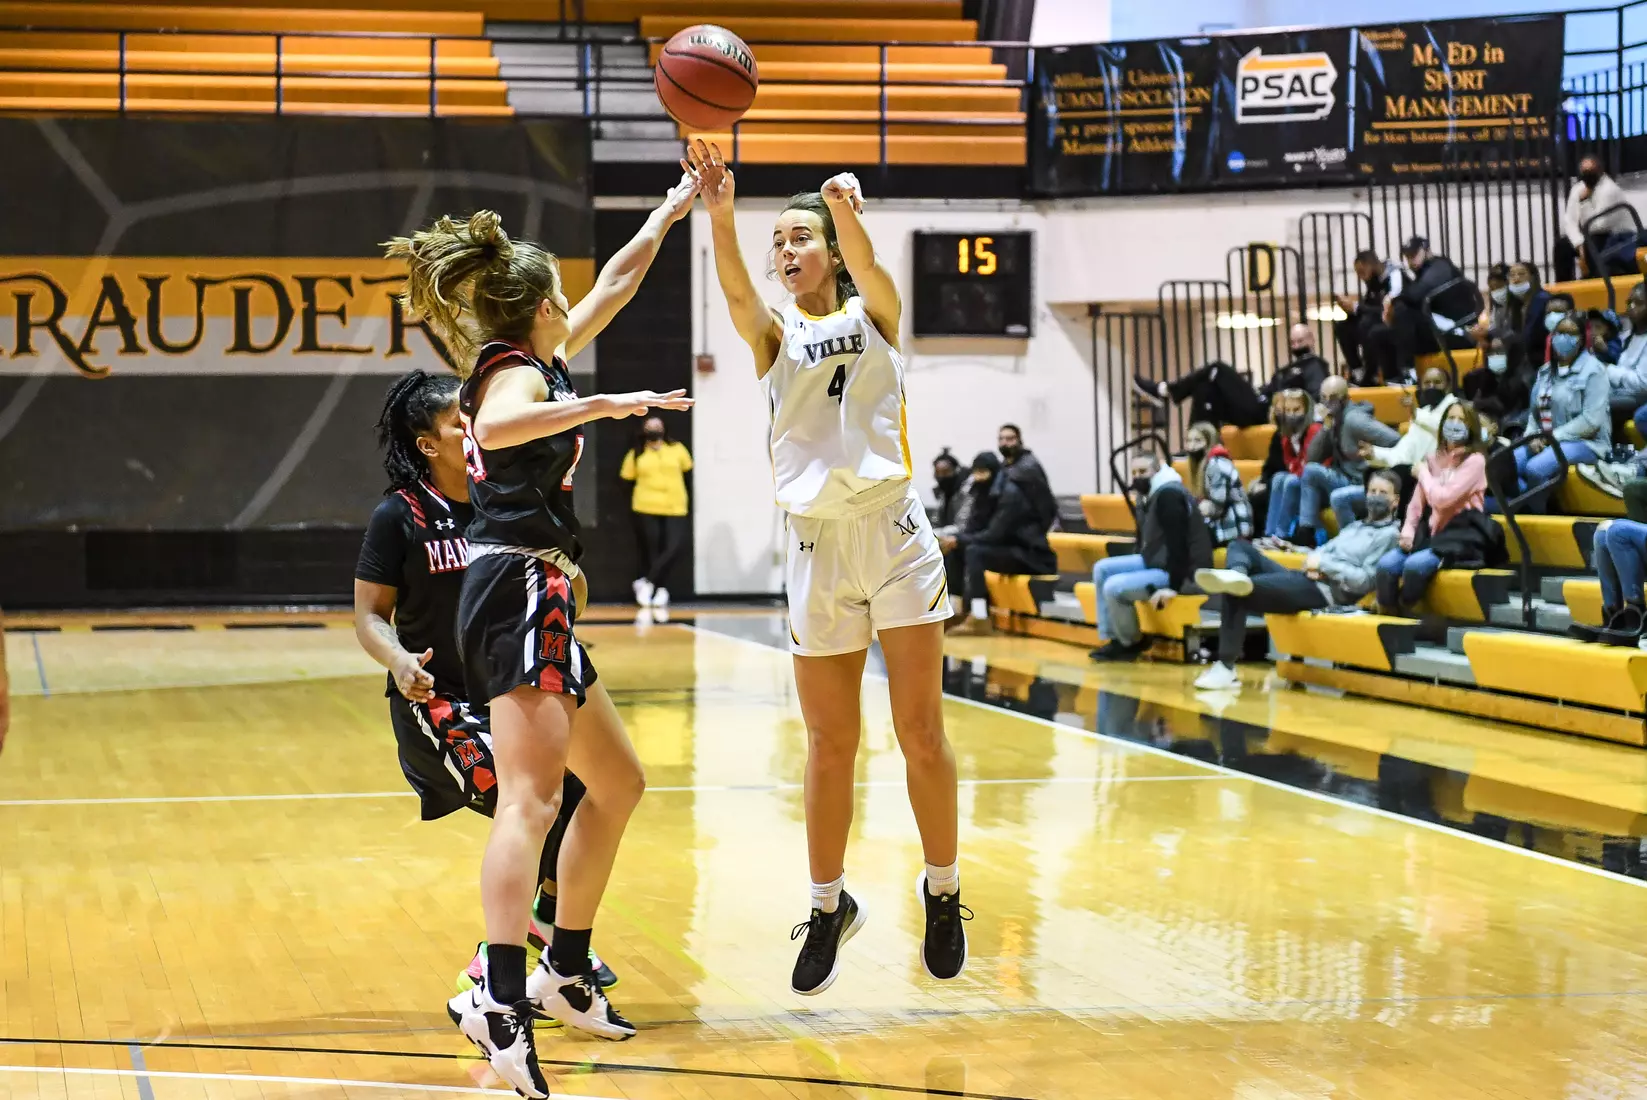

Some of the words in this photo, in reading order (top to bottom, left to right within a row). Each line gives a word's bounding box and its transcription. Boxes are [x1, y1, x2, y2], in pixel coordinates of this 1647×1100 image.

[1483, 41, 1505, 64] in
[1241, 72, 1328, 100] PSAC
[1424, 69, 1488, 91] SPORT
[1385, 93, 1533, 118] MANAGEMENT
[958, 237, 997, 275] 15
[1248, 243, 1275, 291] D
[0, 269, 461, 379] RAUDER
[803, 333, 865, 364] VILLE
[827, 363, 847, 406] 4
[538, 630, 568, 663] M
[453, 737, 485, 771] M
